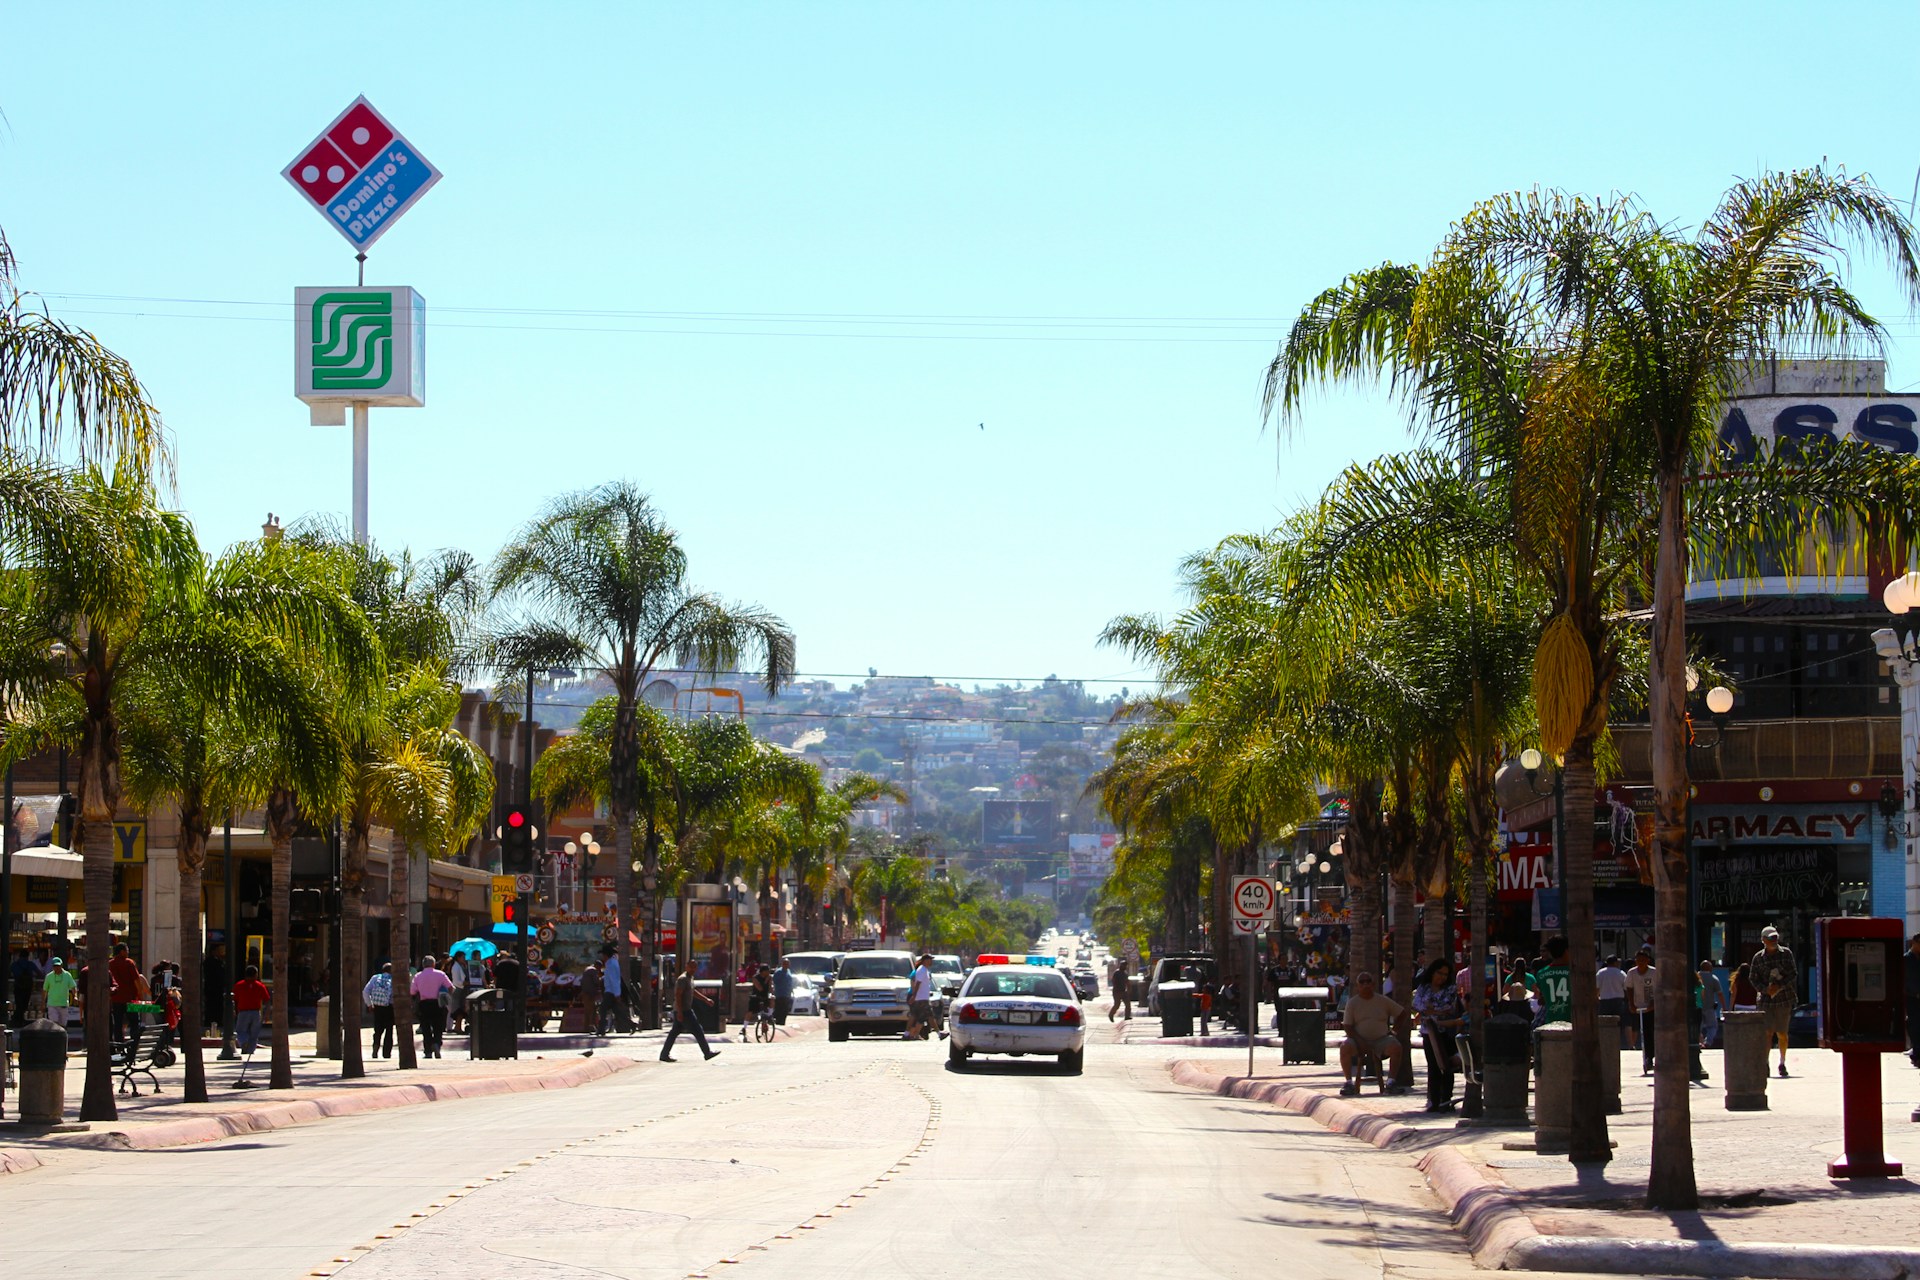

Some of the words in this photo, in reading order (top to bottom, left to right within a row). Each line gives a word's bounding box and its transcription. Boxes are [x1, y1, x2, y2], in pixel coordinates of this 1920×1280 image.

[332, 152, 407, 222] Domino's
[492, 884, 516, 893] DIAL
[1242, 885, 1264, 898] 40
[1700, 872, 1833, 909] PHARMACY
[1243, 900, 1265, 909] km/h
[1546, 977, 1570, 1003] 14
